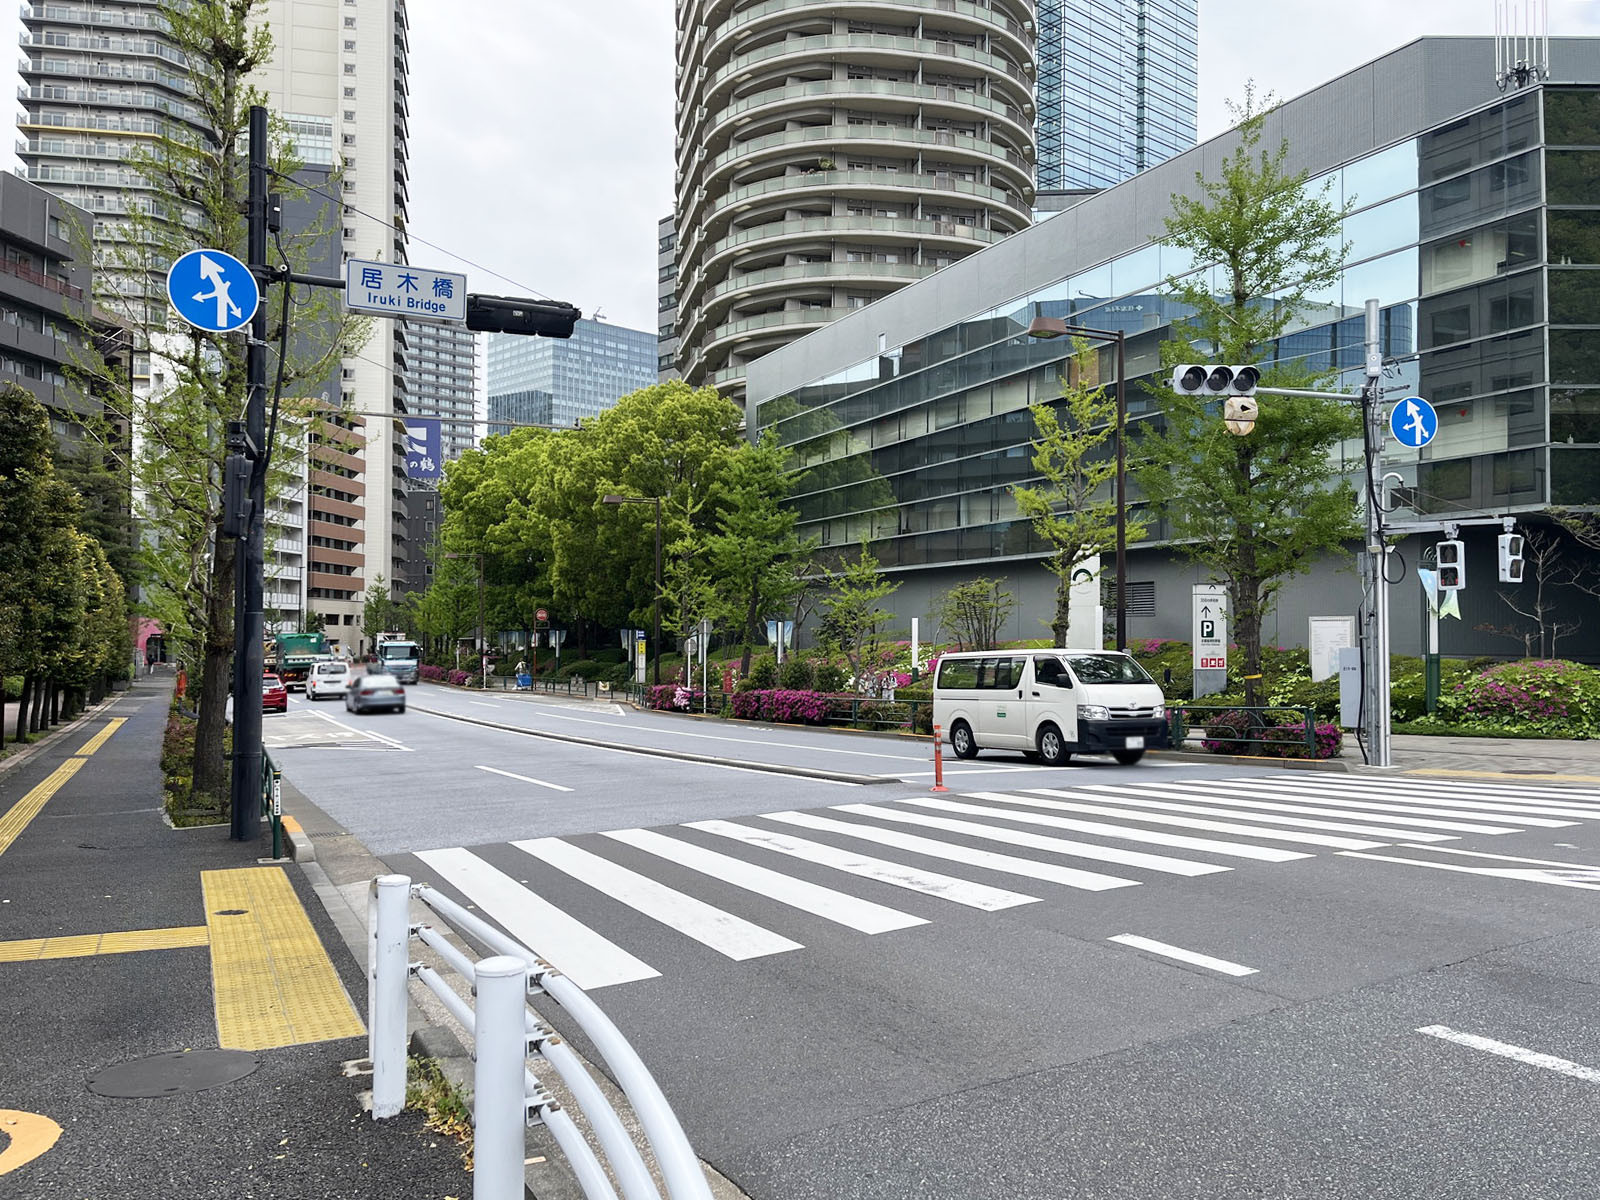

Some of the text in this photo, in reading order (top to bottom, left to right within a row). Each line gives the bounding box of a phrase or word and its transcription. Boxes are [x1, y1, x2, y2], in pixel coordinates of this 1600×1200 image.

[361, 267, 453, 299] 居木橋
[367, 292, 446, 312] Iruki Bridge
[1203, 622, 1212, 637] P
